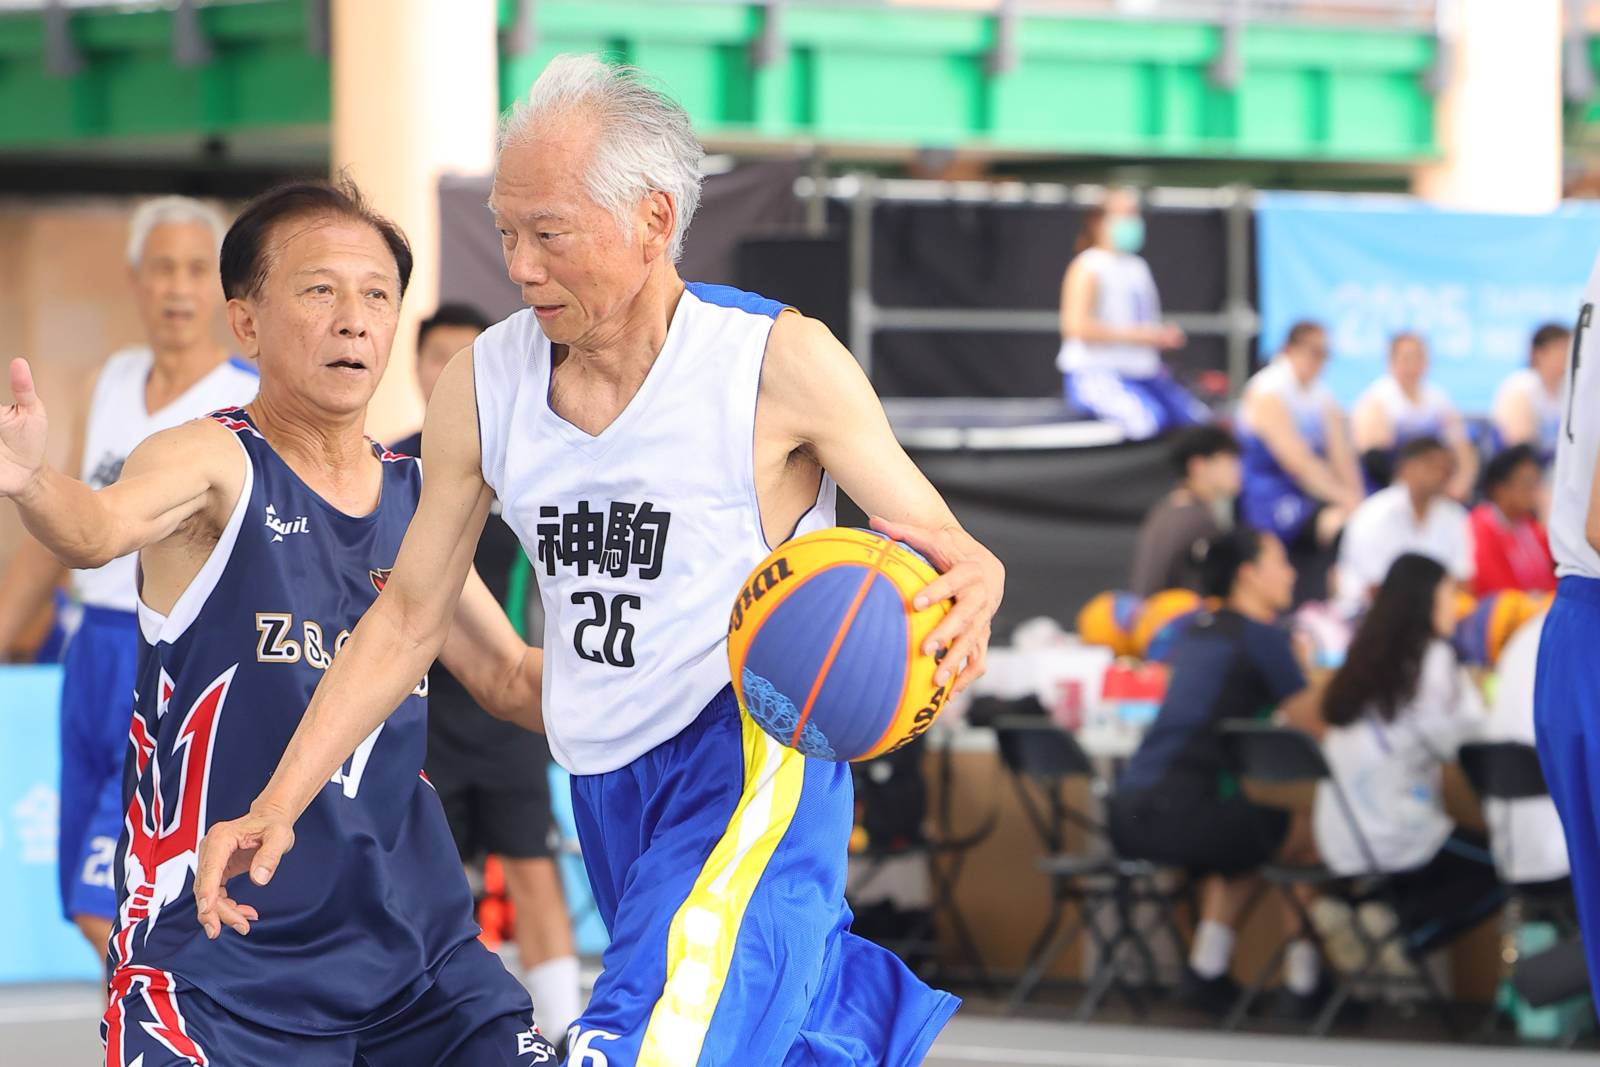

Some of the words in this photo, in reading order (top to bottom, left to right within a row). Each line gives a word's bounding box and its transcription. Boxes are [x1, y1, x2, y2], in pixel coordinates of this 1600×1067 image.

[537, 500, 671, 580] 神駒
[571, 591, 641, 668] 26
[82, 835, 117, 890] 2
